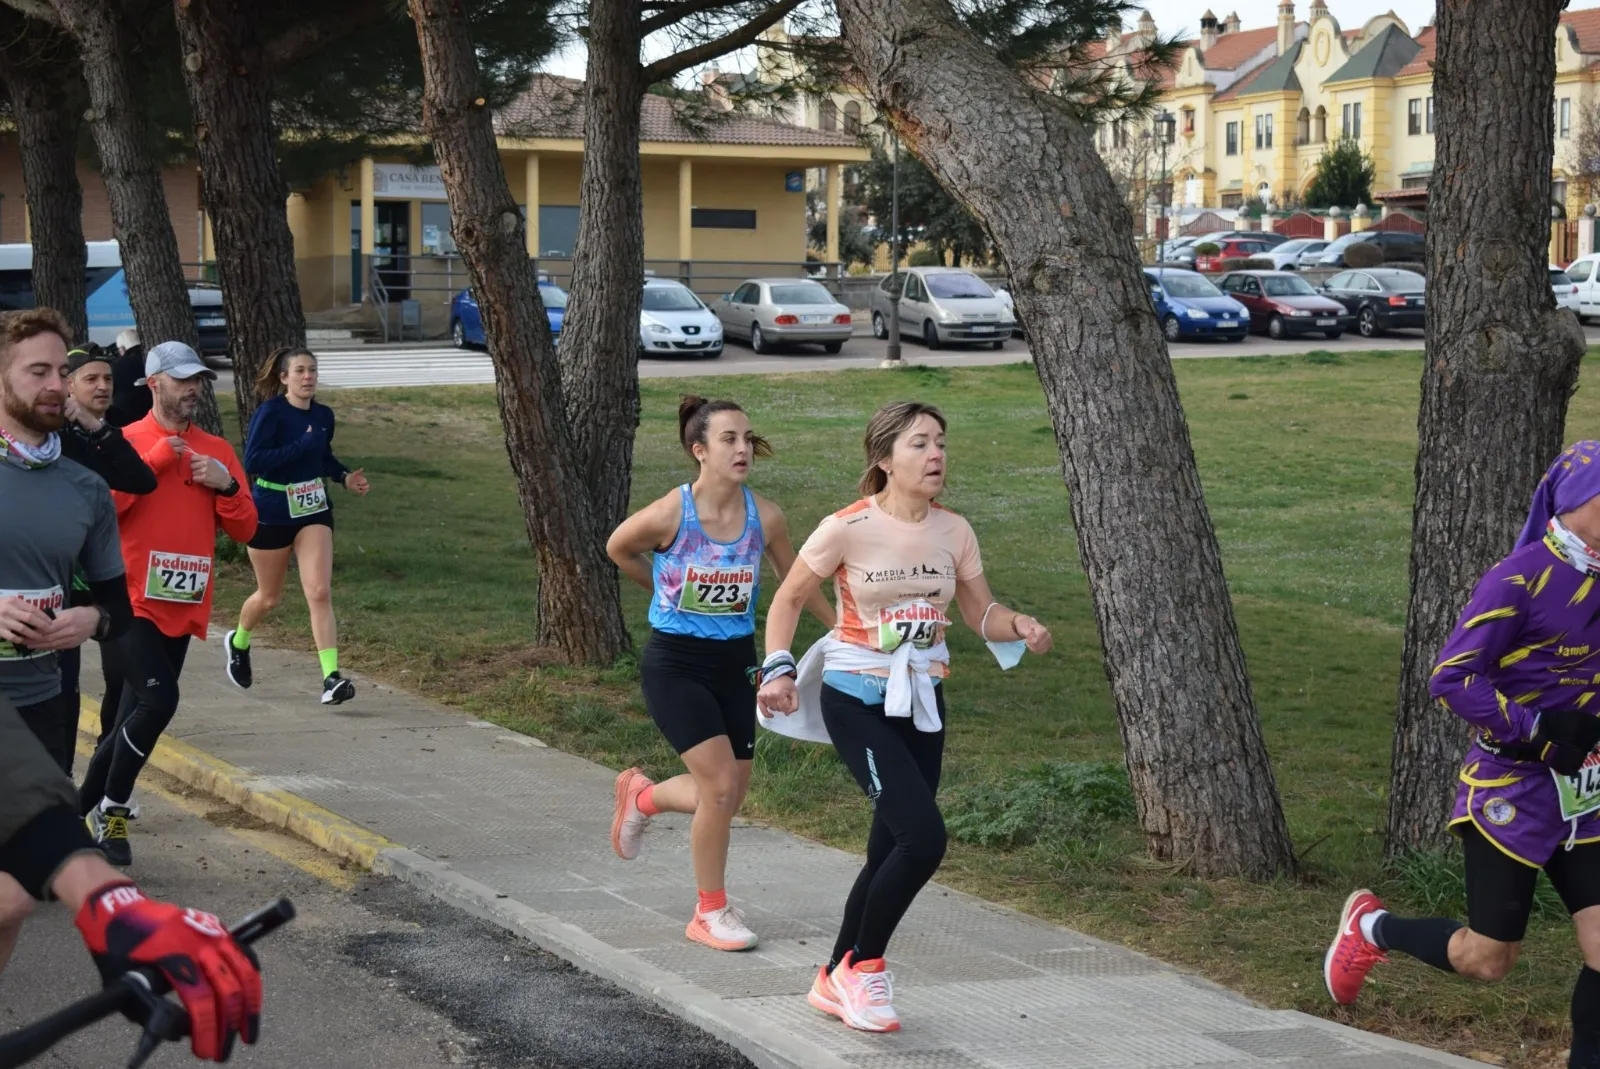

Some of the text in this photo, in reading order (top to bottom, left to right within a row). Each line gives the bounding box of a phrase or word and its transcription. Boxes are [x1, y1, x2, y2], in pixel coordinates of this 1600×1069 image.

[389, 173, 419, 182] CASA
[297, 490, 320, 508] 756
[151, 554, 210, 574] bedunia
[161, 570, 197, 591] 721
[687, 567, 753, 584] bedunia
[865, 571, 874, 583] X
[876, 569, 905, 577] MEDIA
[697, 584, 740, 604] 723
[101, 886, 146, 914] FOX
